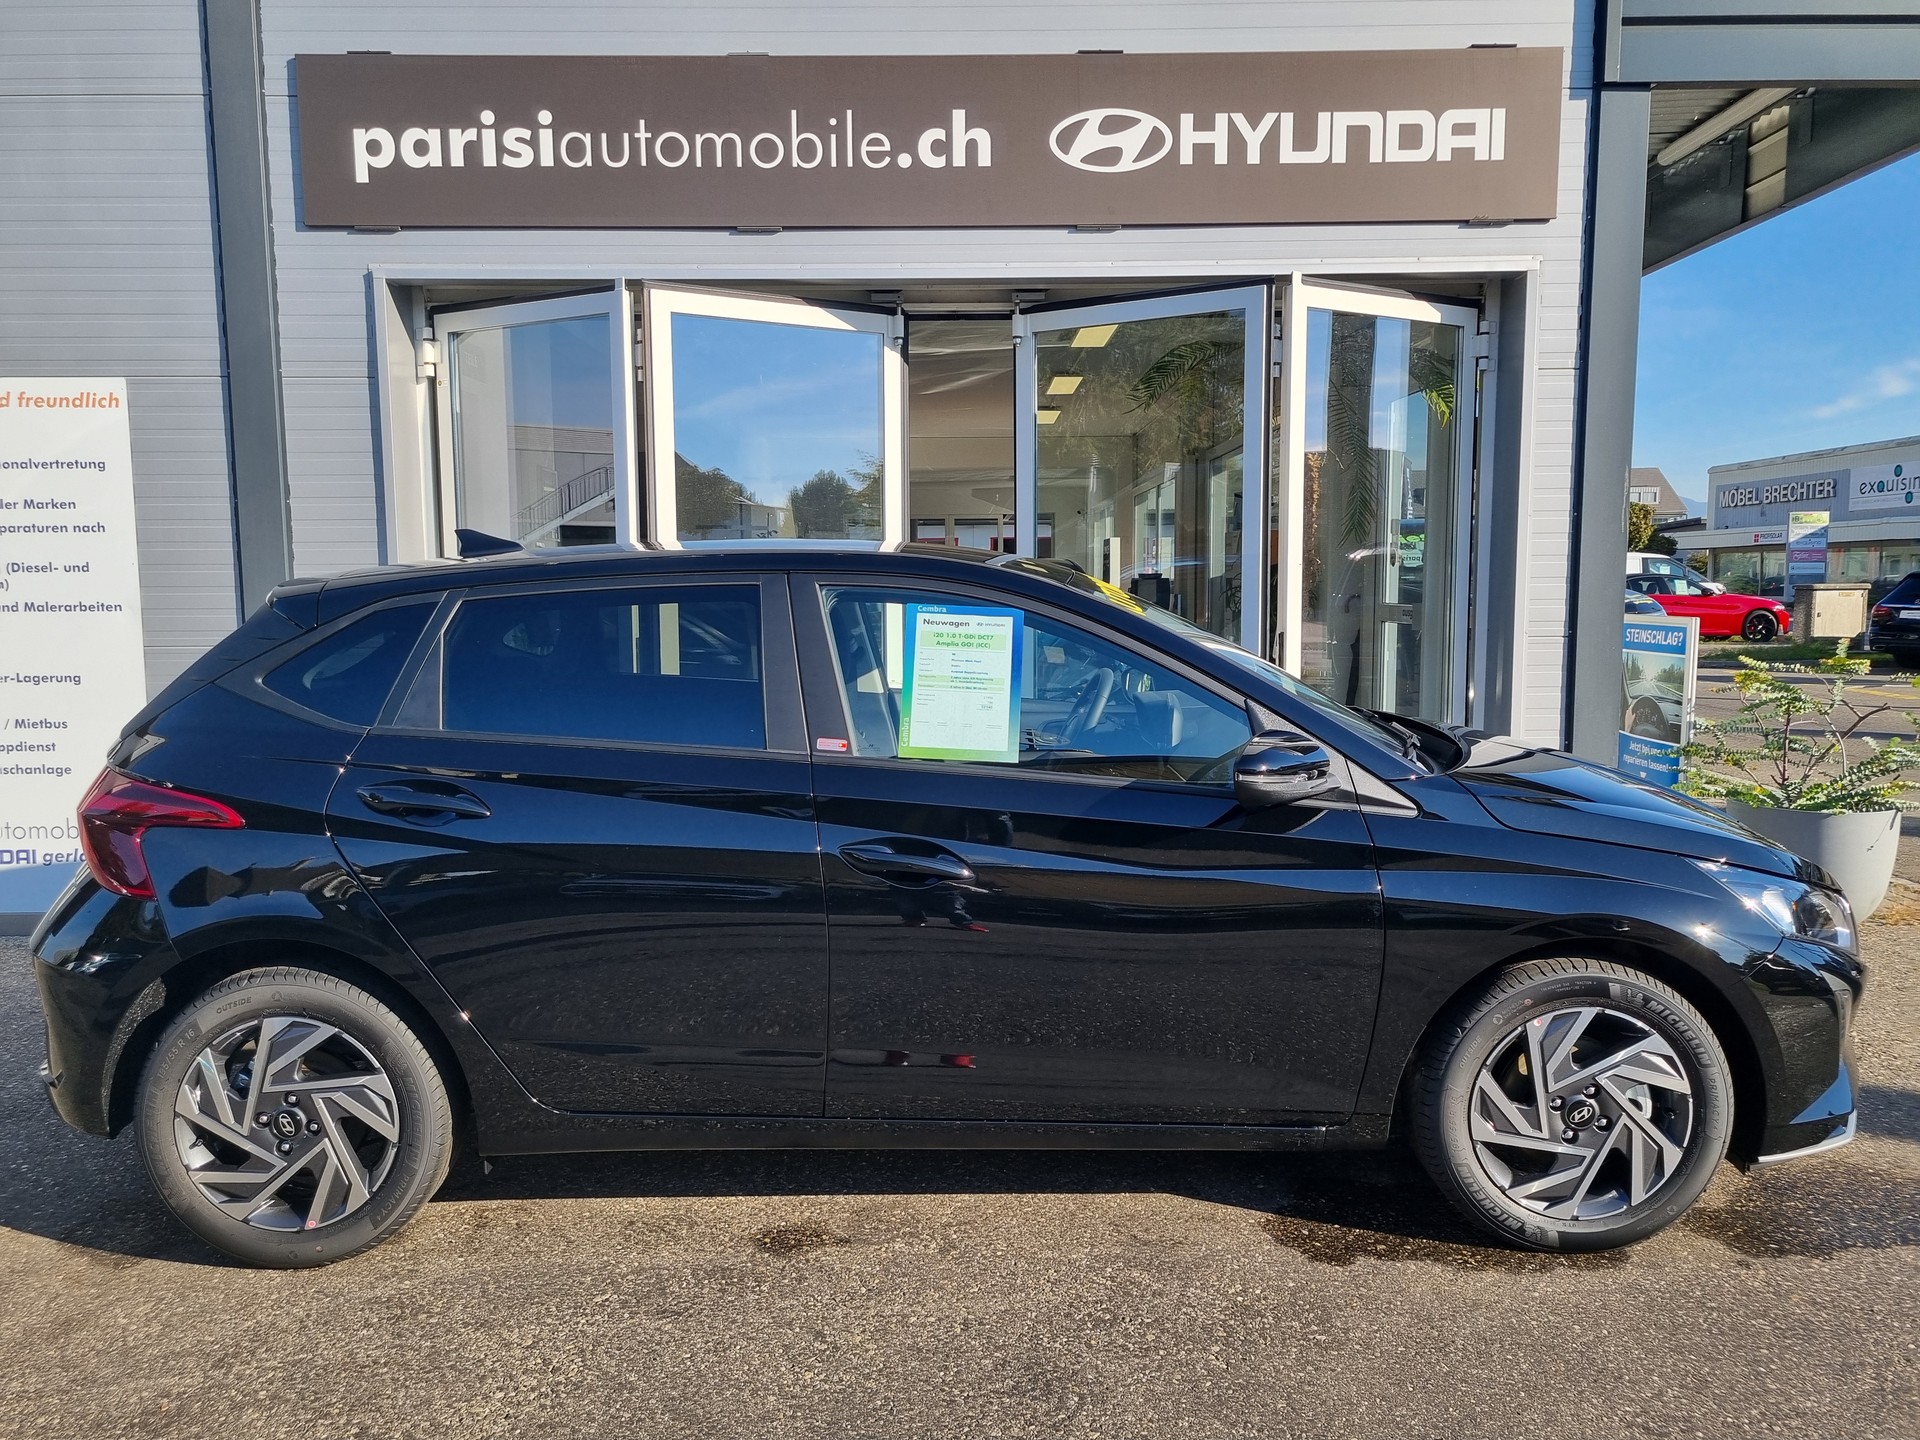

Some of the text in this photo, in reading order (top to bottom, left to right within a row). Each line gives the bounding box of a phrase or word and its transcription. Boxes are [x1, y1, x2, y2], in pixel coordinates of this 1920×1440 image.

[353, 107, 1507, 184] parisiautomobile.ch HYUNDAI
[17, 391, 120, 409] freundlich
[0, 458, 107, 472] onalvertretung
[1719, 478, 1836, 508] MÖBEL BRECHTER
[23, 498, 77, 510] Marken
[73, 522, 106, 533] nach
[6, 562, 90, 576] (Diesel- und
[0, 601, 123, 613] nd Malerarbeiten
[917, 605, 947, 613] Cembra
[923, 618, 970, 628] Neuwagen
[935, 640, 959, 648] Amplia
[1625, 628, 1684, 646] STEINSCHLAG?
[14, 718, 68, 729] Mietbus
[901, 717, 910, 747] Cembra
[0, 764, 72, 777] schanlage
[1623, 754, 1669, 773] reparieren lassen!
[216, 996, 252, 1015] OUTSIDE
[177, 1039, 186, 1049] R
[185, 1028, 195, 1040] 16
[1645, 1000, 1712, 1066] MICHELIN
[1459, 1035, 1482, 1070] OUTSIDE
[1709, 1078, 1721, 1125] PRIMACY
[382, 1175, 410, 1215] PRIMACY
[1457, 1166, 1523, 1231] MICHELIN
